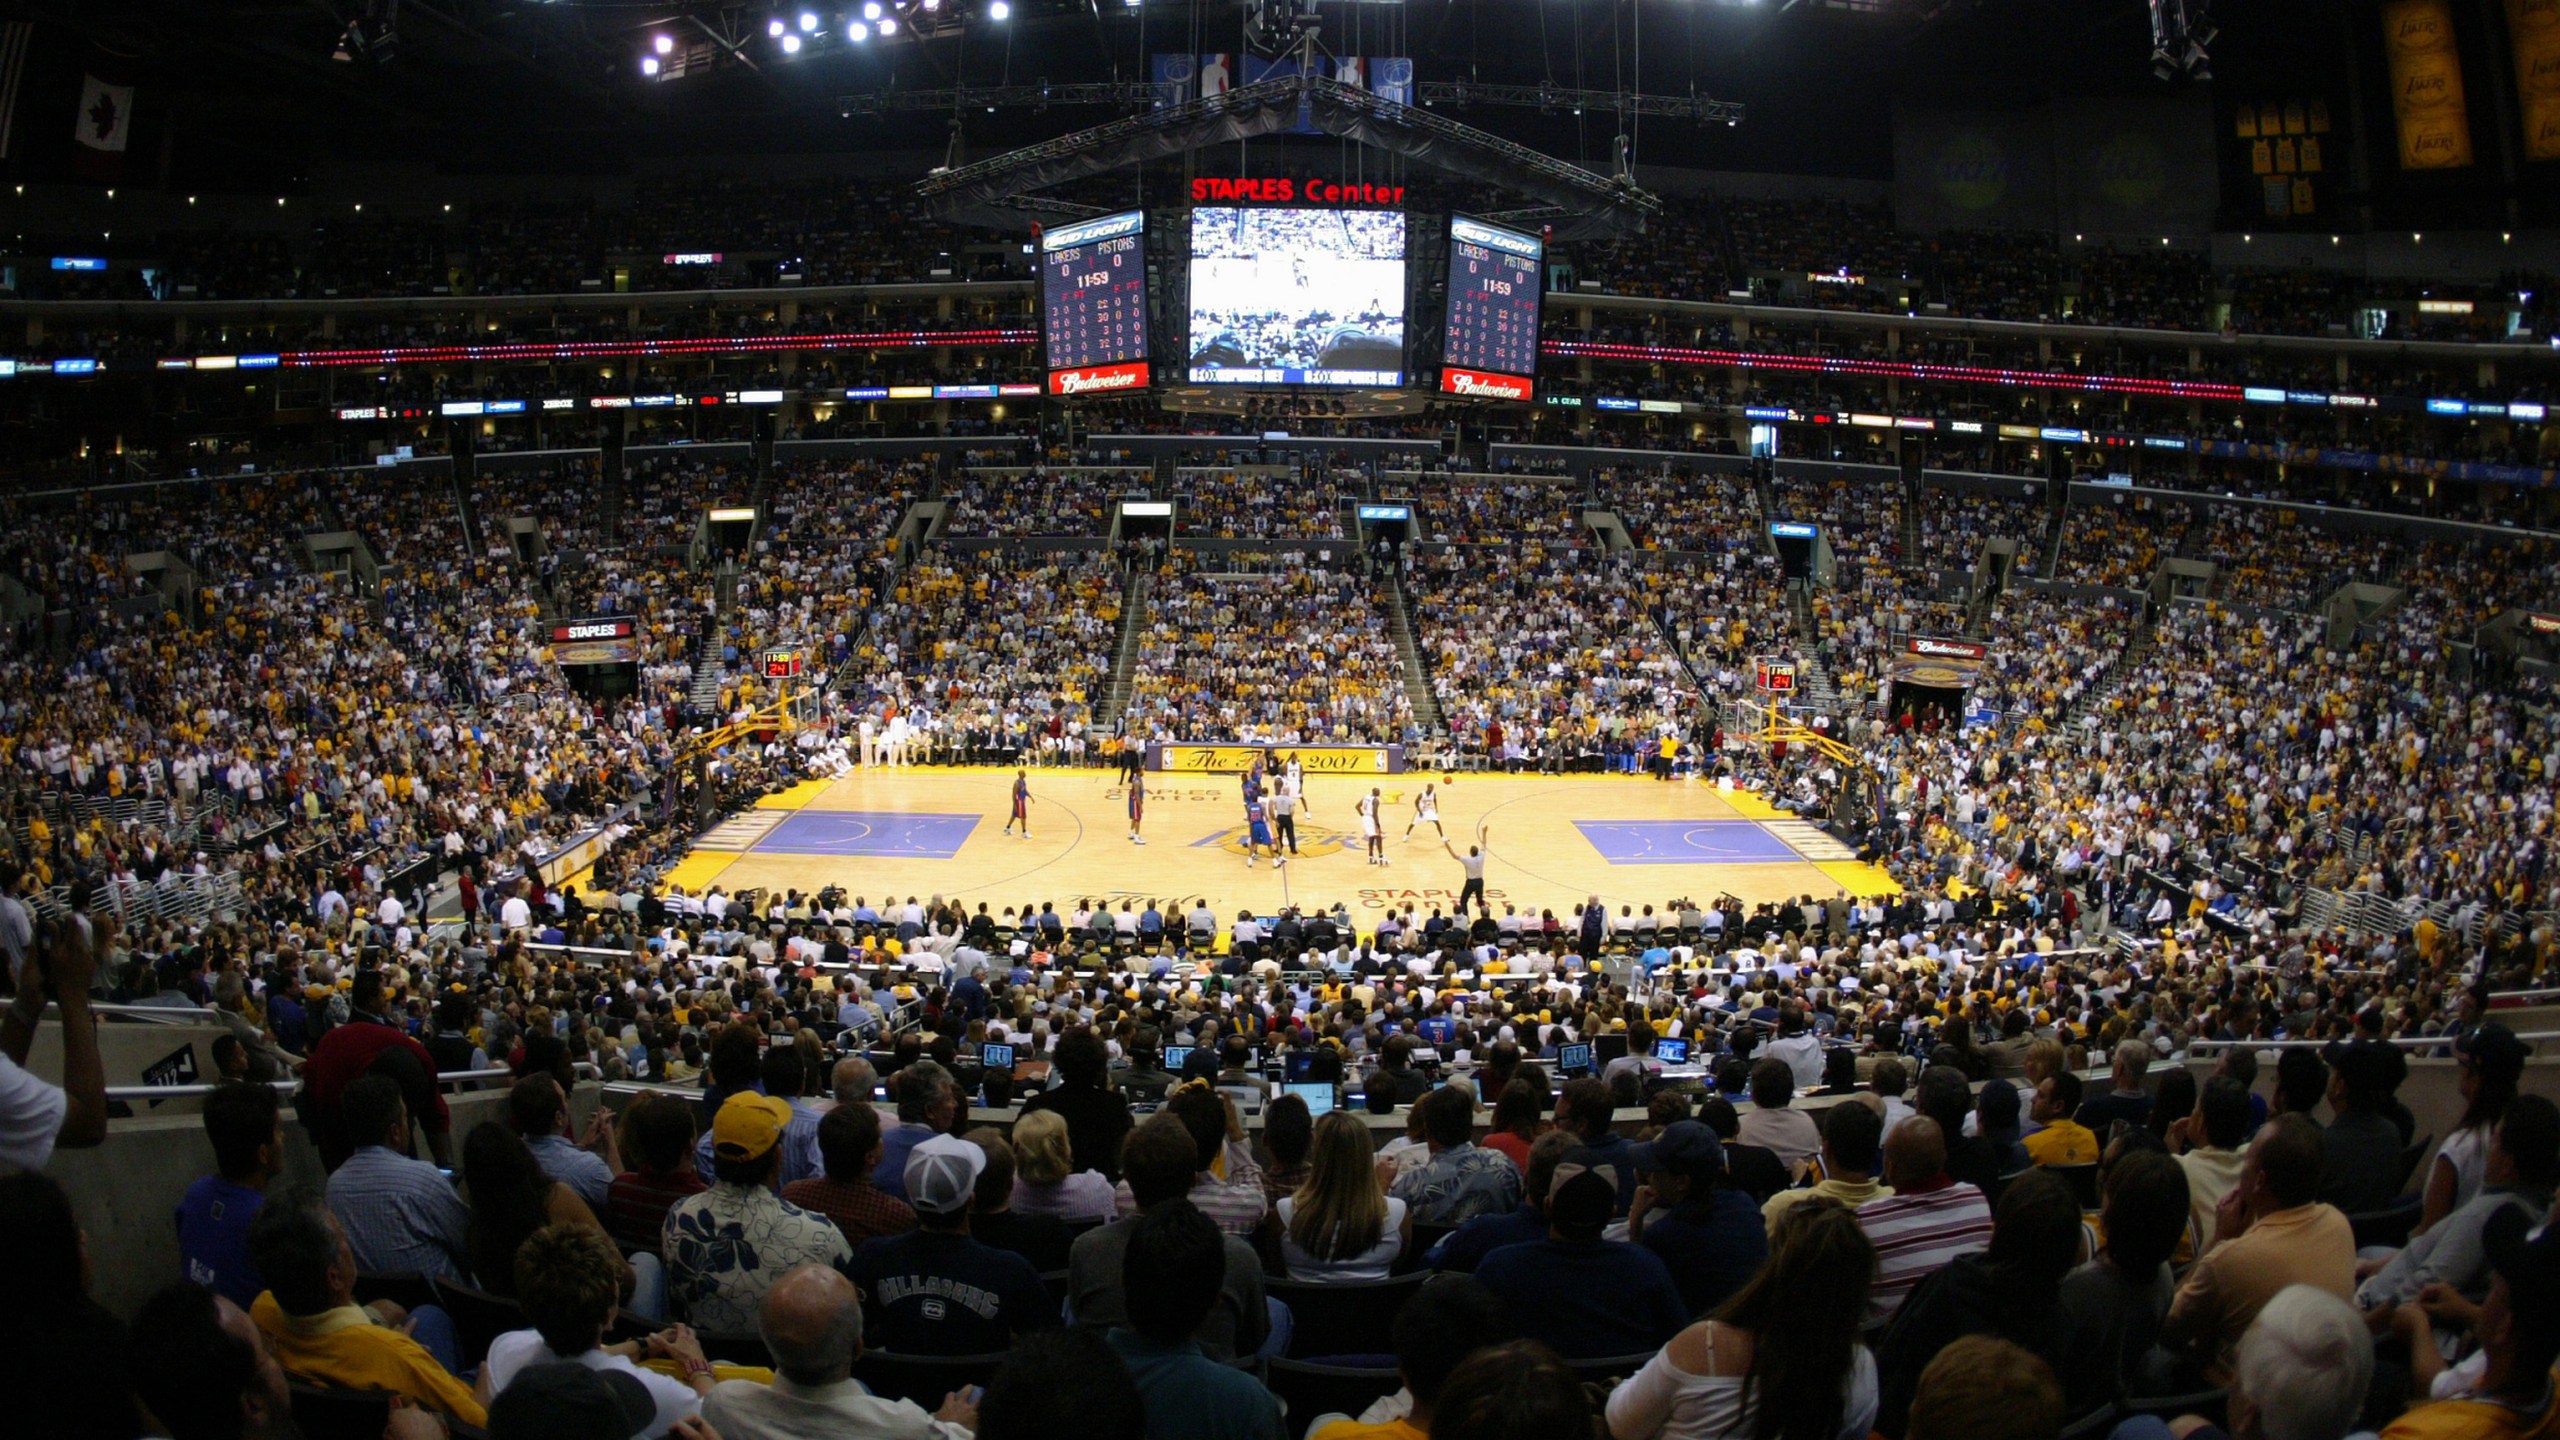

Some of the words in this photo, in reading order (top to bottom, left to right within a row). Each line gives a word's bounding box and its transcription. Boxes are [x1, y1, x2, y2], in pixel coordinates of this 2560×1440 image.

[1192, 178, 1294, 200] STAPLES
[1305, 178, 1404, 203] Center
[1084, 220, 1137, 240] LIGHT
[1050, 248, 1081, 265] LAKERS
[1098, 237, 1135, 255] PISTONS
[1491, 235, 1537, 254] LIGHT
[1062, 264, 1070, 277] 0
[1113, 254, 1122, 267] 0
[1458, 242, 1489, 262] LAKERS
[1504, 254, 1535, 273] PISTONS
[1077, 271, 1109, 288] 11:59
[1469, 260, 1477, 273] 0
[1516, 272, 1523, 284] 0
[1483, 278, 1512, 296] 11:59
[1115, 297, 1121, 306] 0
[1132, 294, 1139, 304] 0
[1097, 312, 1109, 322] 30
[1133, 307, 1140, 317] 0
[1116, 323, 1123, 333] 0
[1133, 321, 1140, 331] 0
[1117, 337, 1123, 347] 0
[1134, 335, 1141, 345] 0
[1060, 371, 1136, 394] Budweiser
[1452, 374, 1522, 398] Budweiser
[543, 400, 573, 409] XEROX
[602, 398, 631, 408] TOYOTA
[340, 408, 375, 419] STAPLES
[1952, 422, 1982, 432] XEROX
[569, 624, 616, 638] STAPLES
[1916, 640, 1975, 656] Budweiser
[769, 664, 786, 675] 24
[1773, 676, 1790, 688] 24
[1188, 750, 1228, 768] The
[1433, 1029, 1443, 1044] 3
